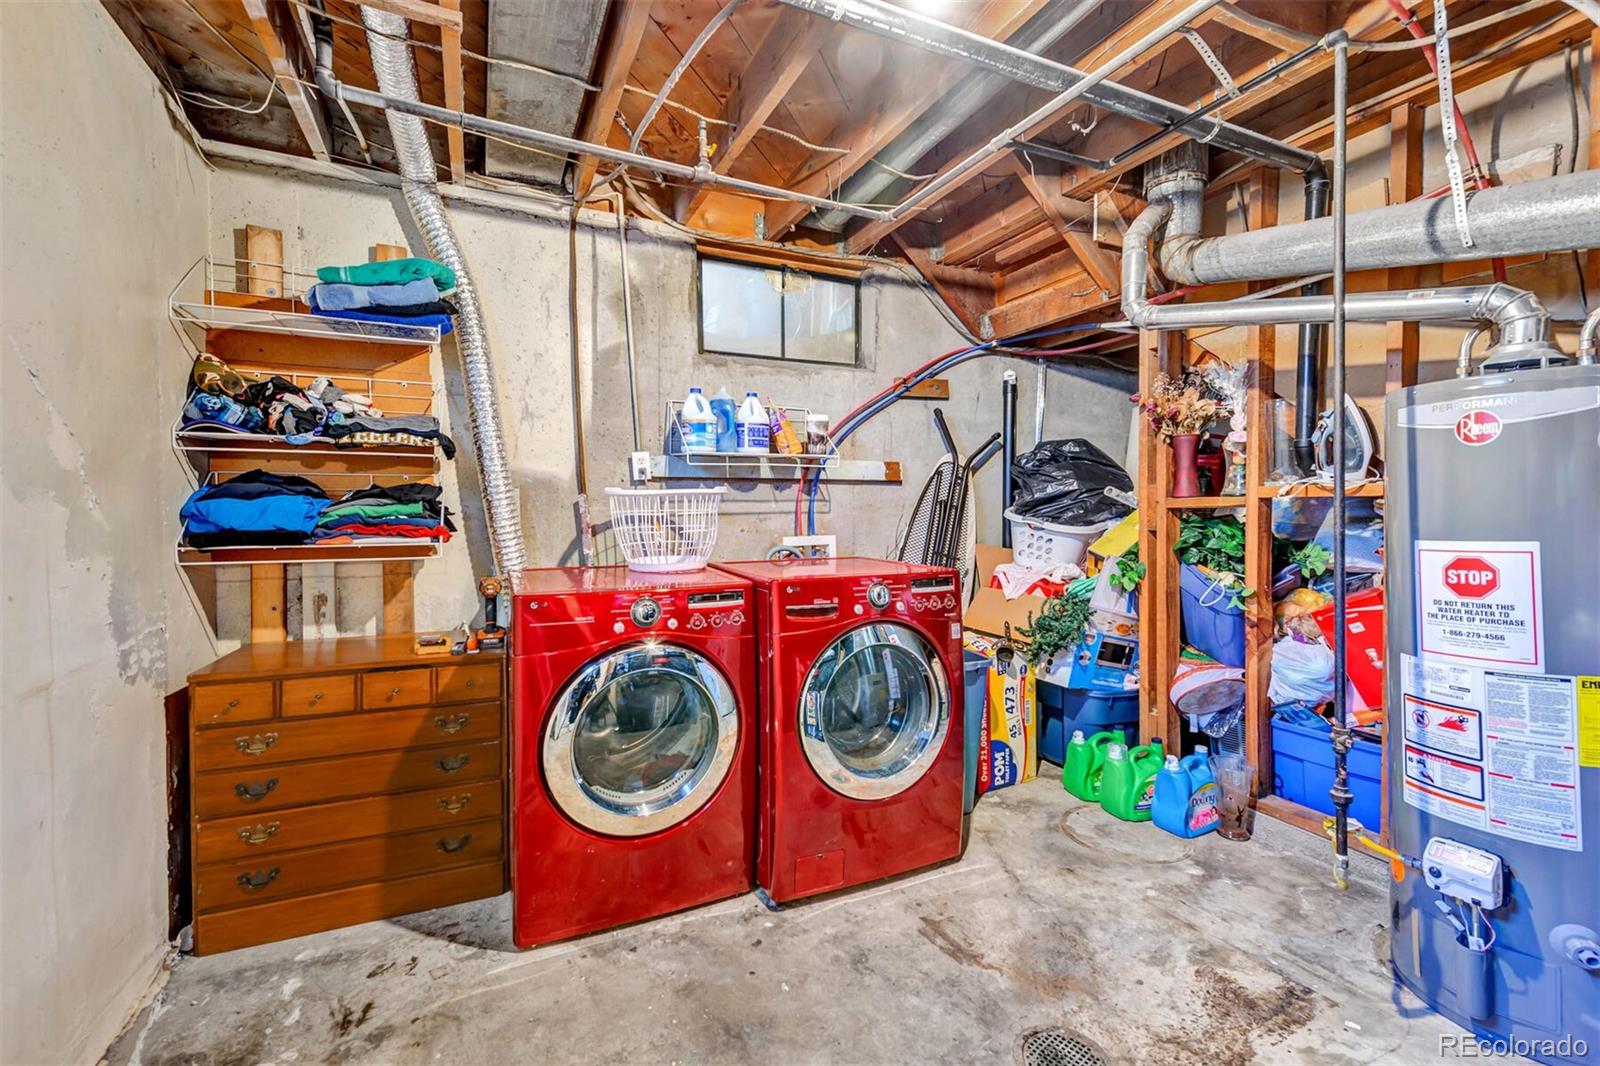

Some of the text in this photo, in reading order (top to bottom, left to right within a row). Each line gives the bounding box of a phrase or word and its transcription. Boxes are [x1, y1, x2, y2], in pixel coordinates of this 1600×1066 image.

[1460, 412, 1499, 441] Rheem
[1447, 569, 1494, 586] STOP
[1437, 606, 1462, 615] WATER
[1464, 608, 1496, 618] HEATER
[1460, 601, 1493, 610] RETURN
[1441, 613, 1464, 622] PLACE
[1479, 617, 1526, 627] PURCHASE
[1442, 629, 1506, 641] 1-866-279-4566
[1004, 686, 1016, 714] 473
[1009, 724, 1018, 739] 45
[980, 729, 988, 760] 21,000
[980, 762, 988, 782] Over
[994, 751, 1005, 786] POM
